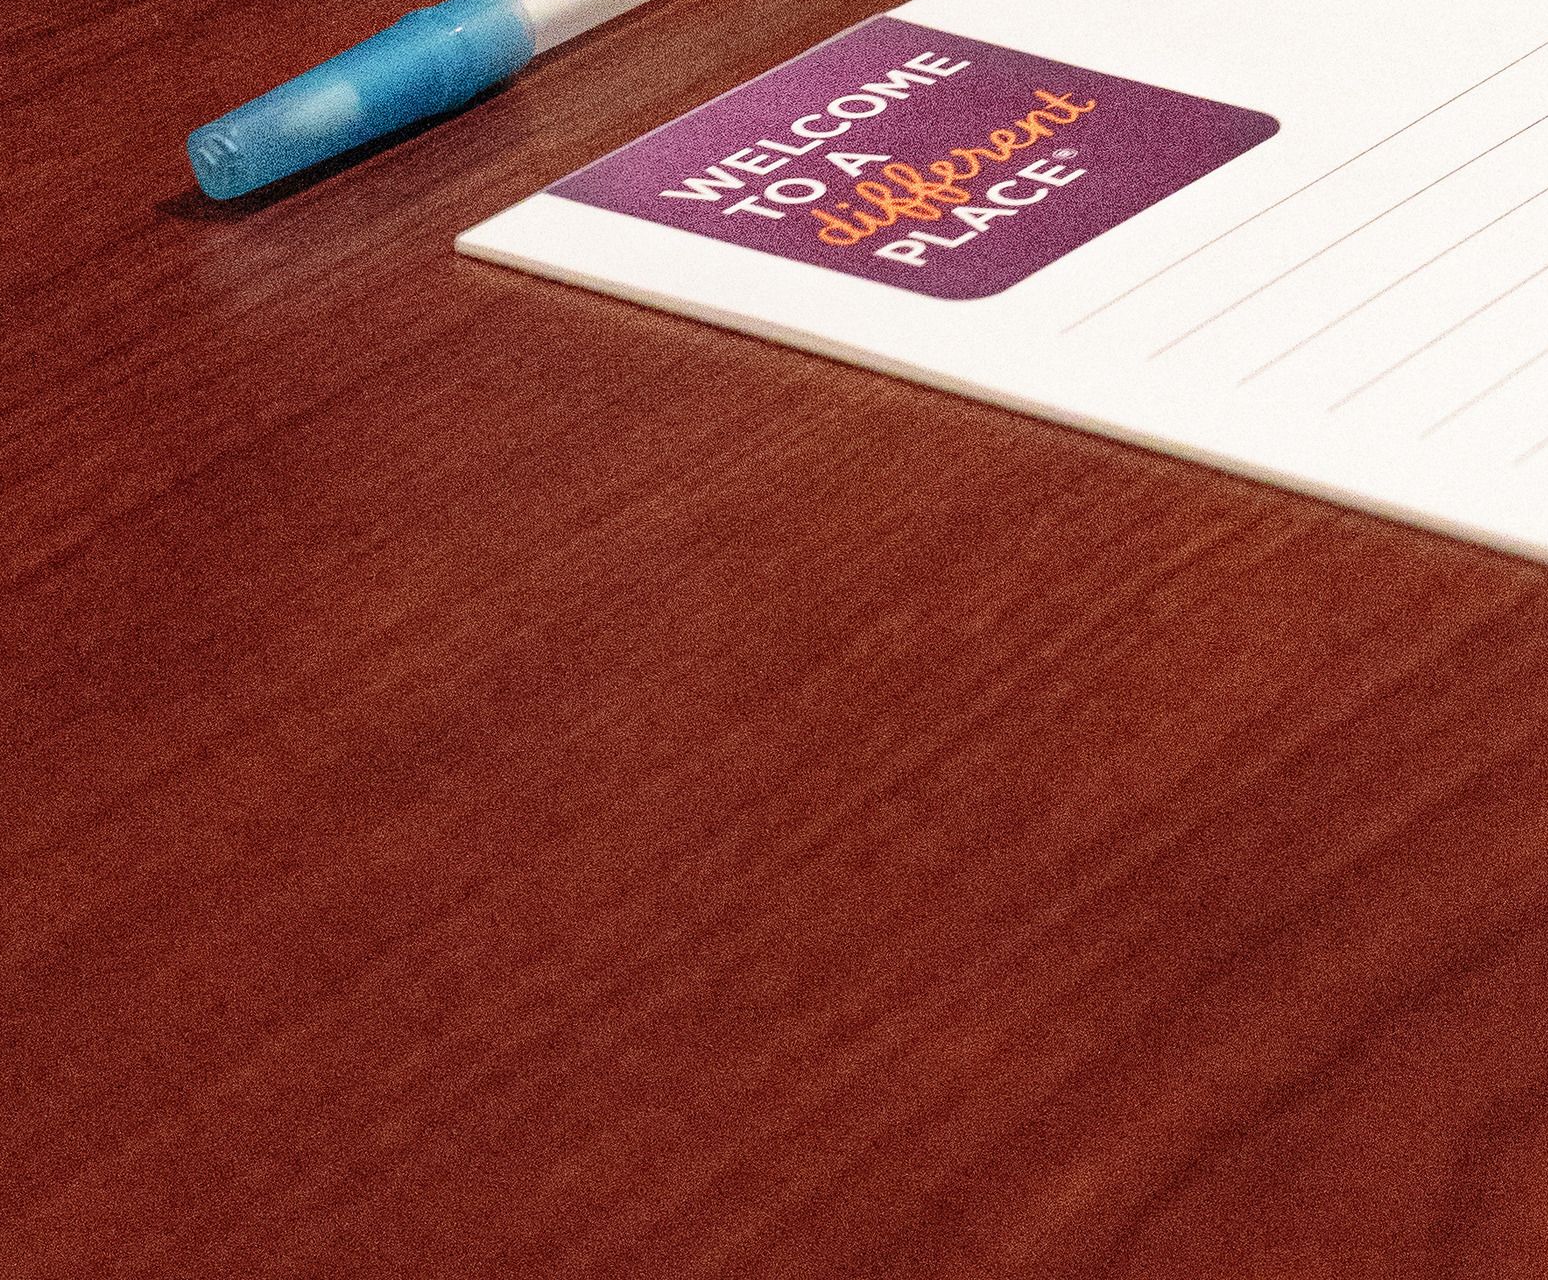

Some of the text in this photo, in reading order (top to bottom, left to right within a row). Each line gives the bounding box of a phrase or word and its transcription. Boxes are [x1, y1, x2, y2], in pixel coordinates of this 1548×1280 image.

[659, 51, 971, 203] WELCOME
[723, 149, 893, 221] TO A
[811, 89, 1097, 247] different
